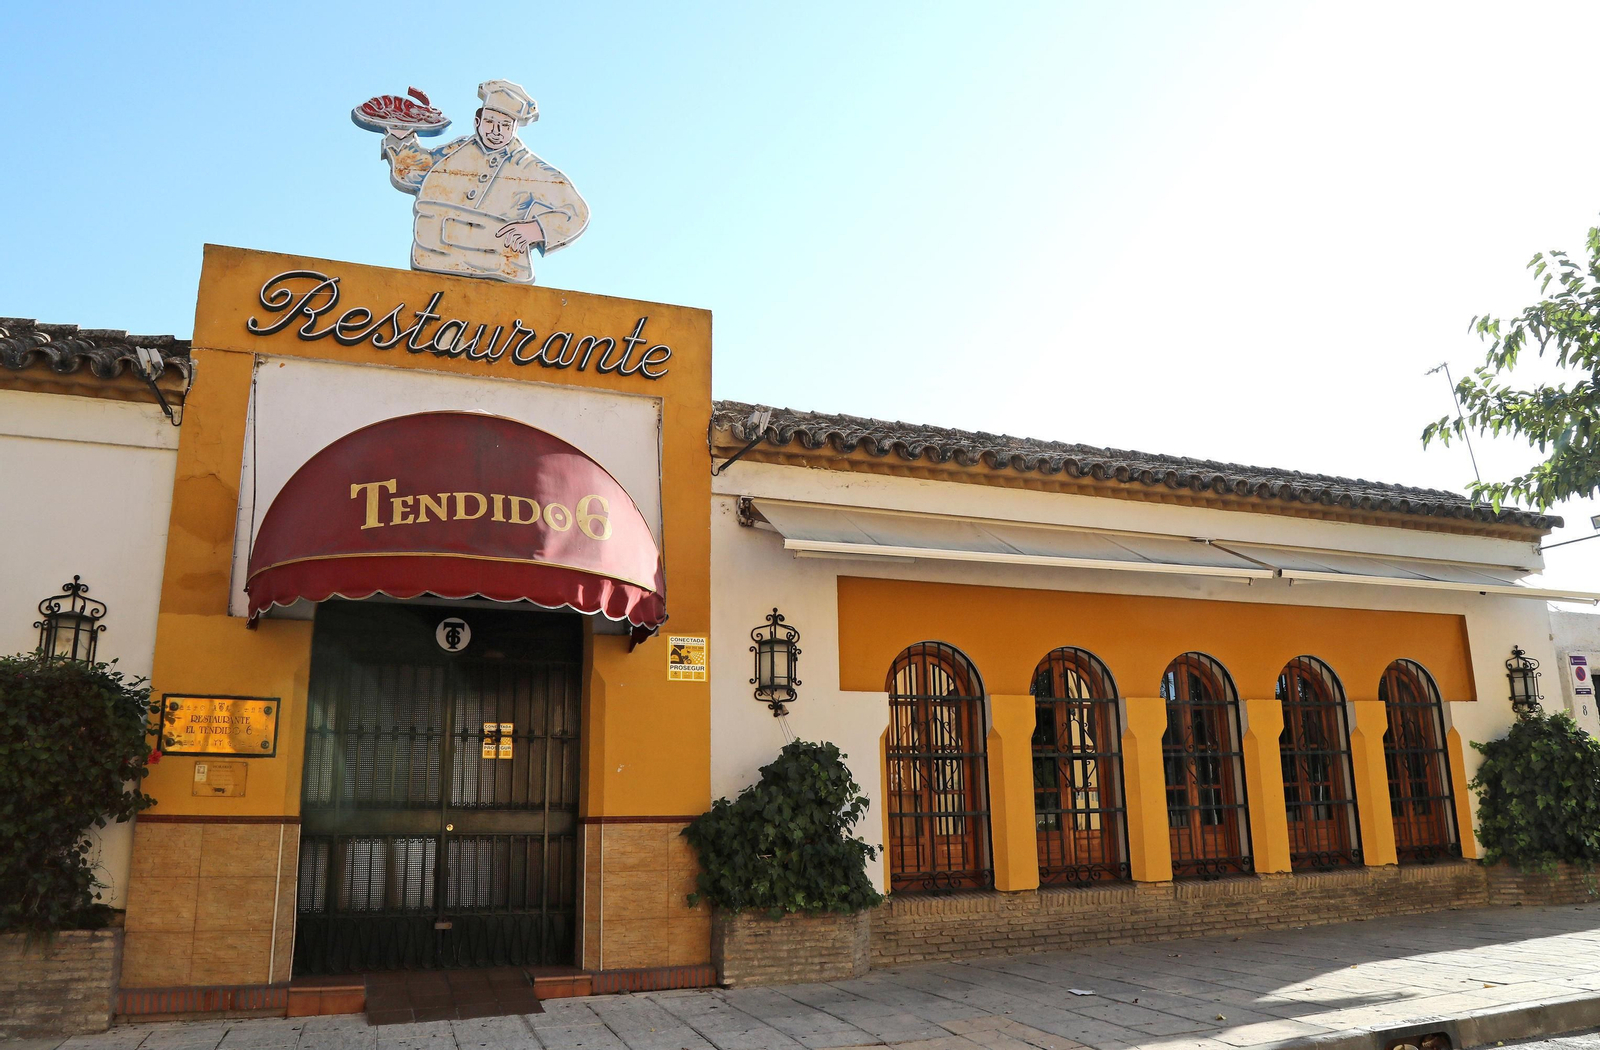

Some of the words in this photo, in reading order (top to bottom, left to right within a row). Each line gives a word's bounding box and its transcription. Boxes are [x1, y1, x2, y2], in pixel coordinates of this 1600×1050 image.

[247, 270, 672, 379] Restaurante
[190, 714, 251, 725] RESTAURANTE
[186, 725, 195, 734] EL
[199, 726, 241, 735] TENDIDO
[246, 725, 252, 735] 6
